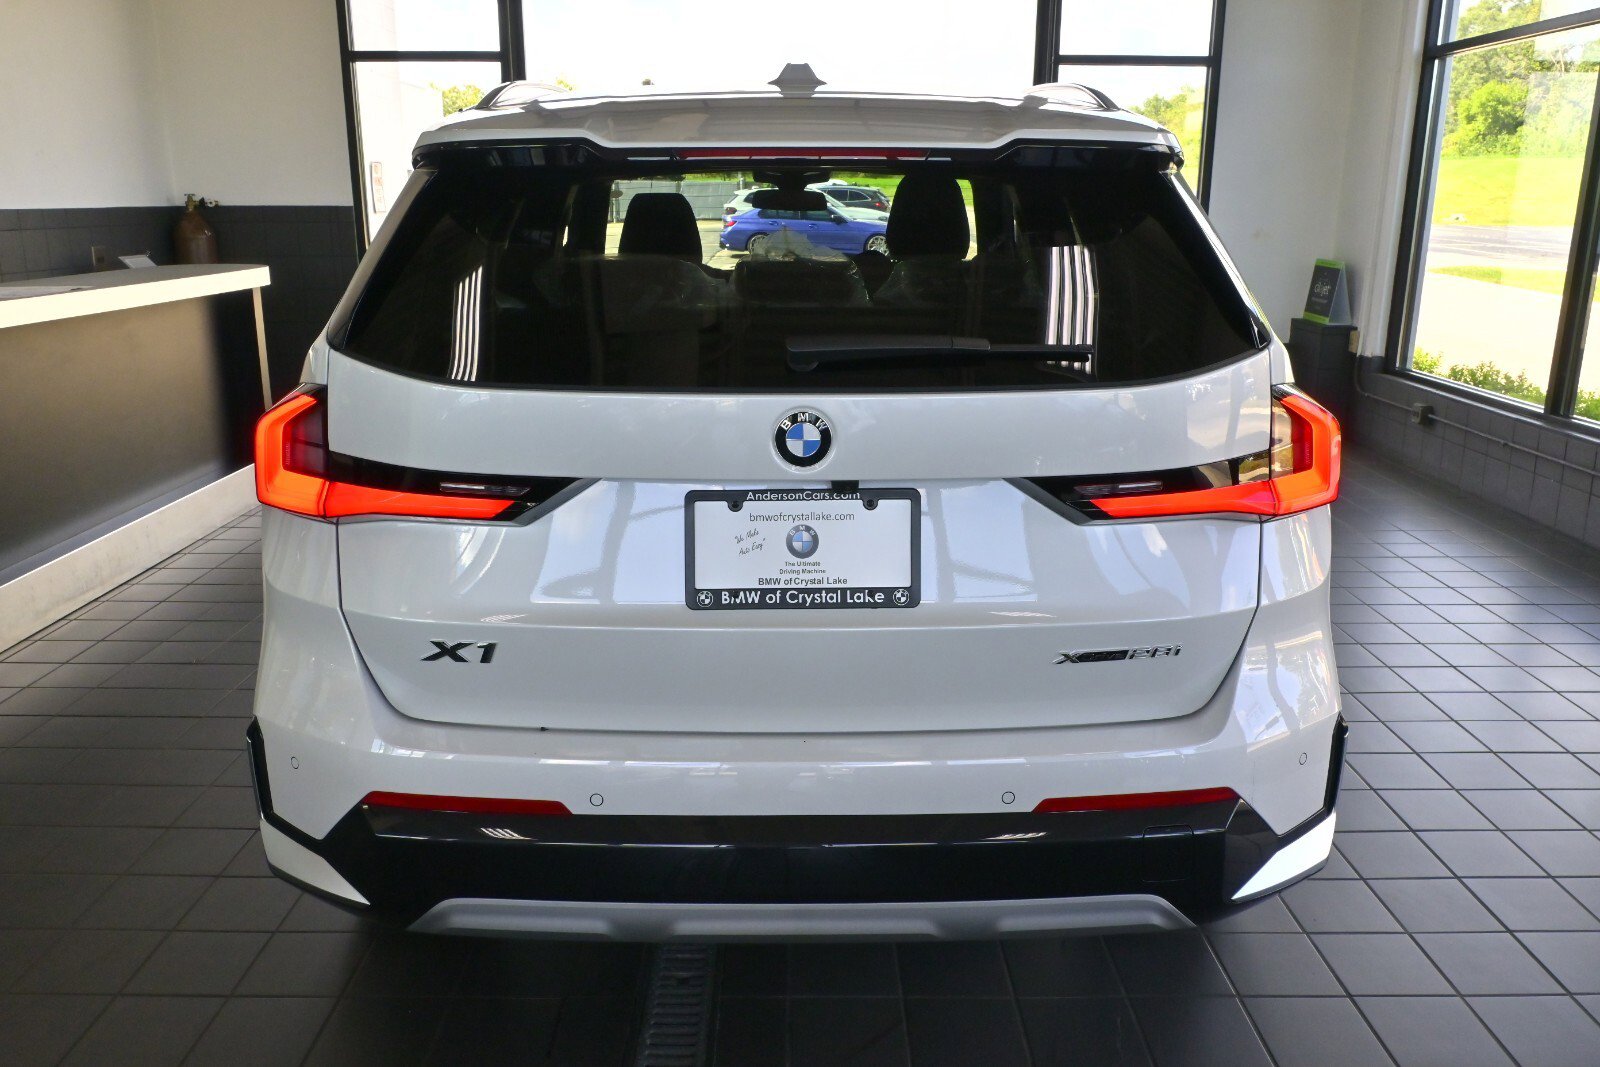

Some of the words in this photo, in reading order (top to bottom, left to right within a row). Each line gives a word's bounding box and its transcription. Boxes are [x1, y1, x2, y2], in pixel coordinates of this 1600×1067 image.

[780, 412, 828, 430] BMW
[749, 512, 855, 523] bmwofcrystallake.com
[790, 525, 816, 536] BMW
[758, 577, 781, 586] BMW
[783, 577, 793, 586] of
[794, 577, 824, 587] Crystal
[827, 576, 848, 585] Lake
[721, 591, 761, 604] BMW
[765, 590, 782, 604] of
[785, 589, 841, 607] Crystal
[846, 590, 885, 603] Lake
[420, 639, 499, 664] X1
